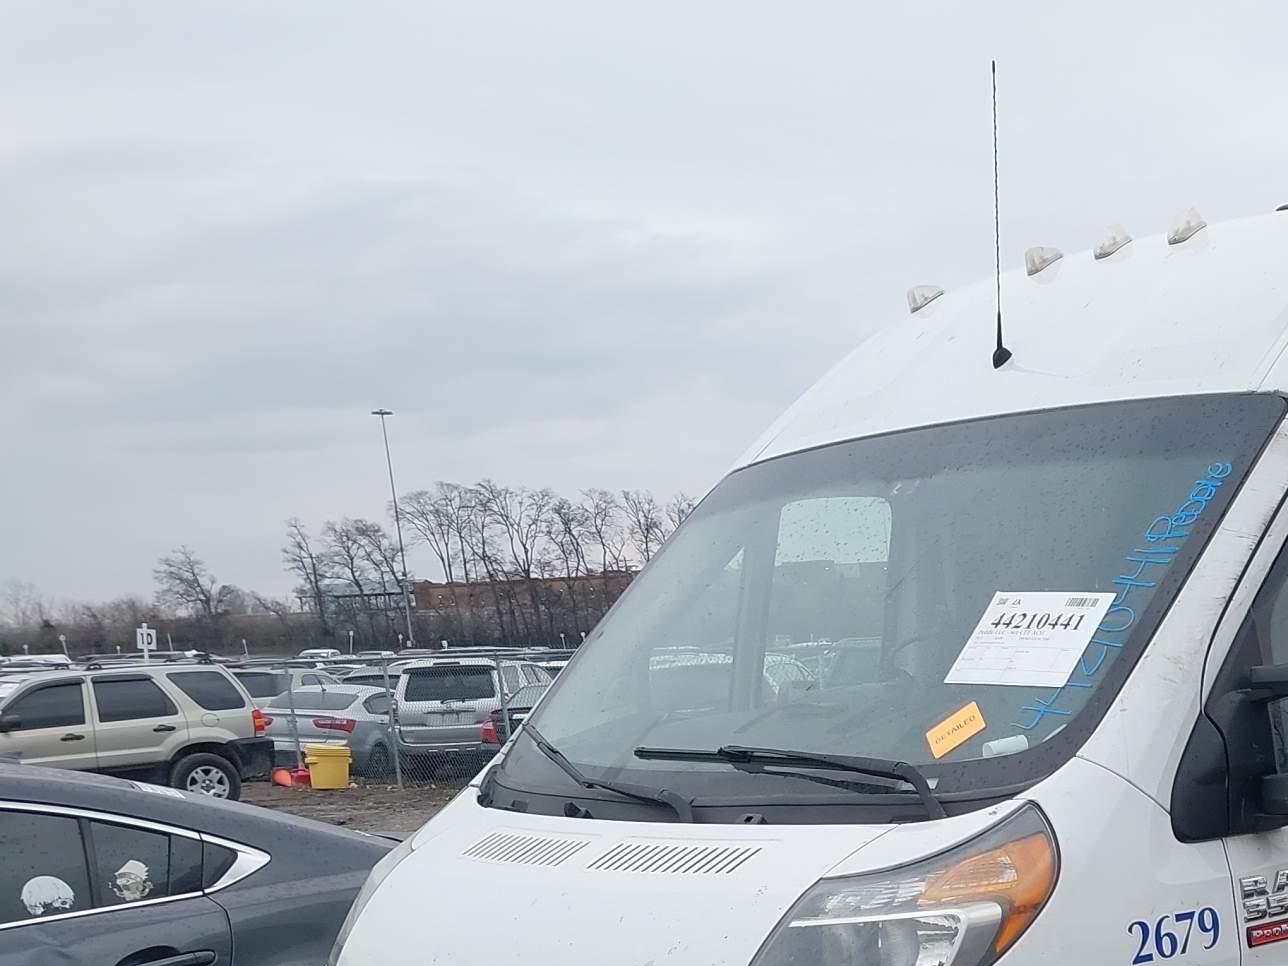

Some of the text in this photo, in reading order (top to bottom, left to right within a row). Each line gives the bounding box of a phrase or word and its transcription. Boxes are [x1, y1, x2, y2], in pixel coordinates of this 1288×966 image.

[991, 612, 1086, 631] 44210441
[934, 715, 976, 745] DETAILED
[1126, 906, 1221, 966] 2679
